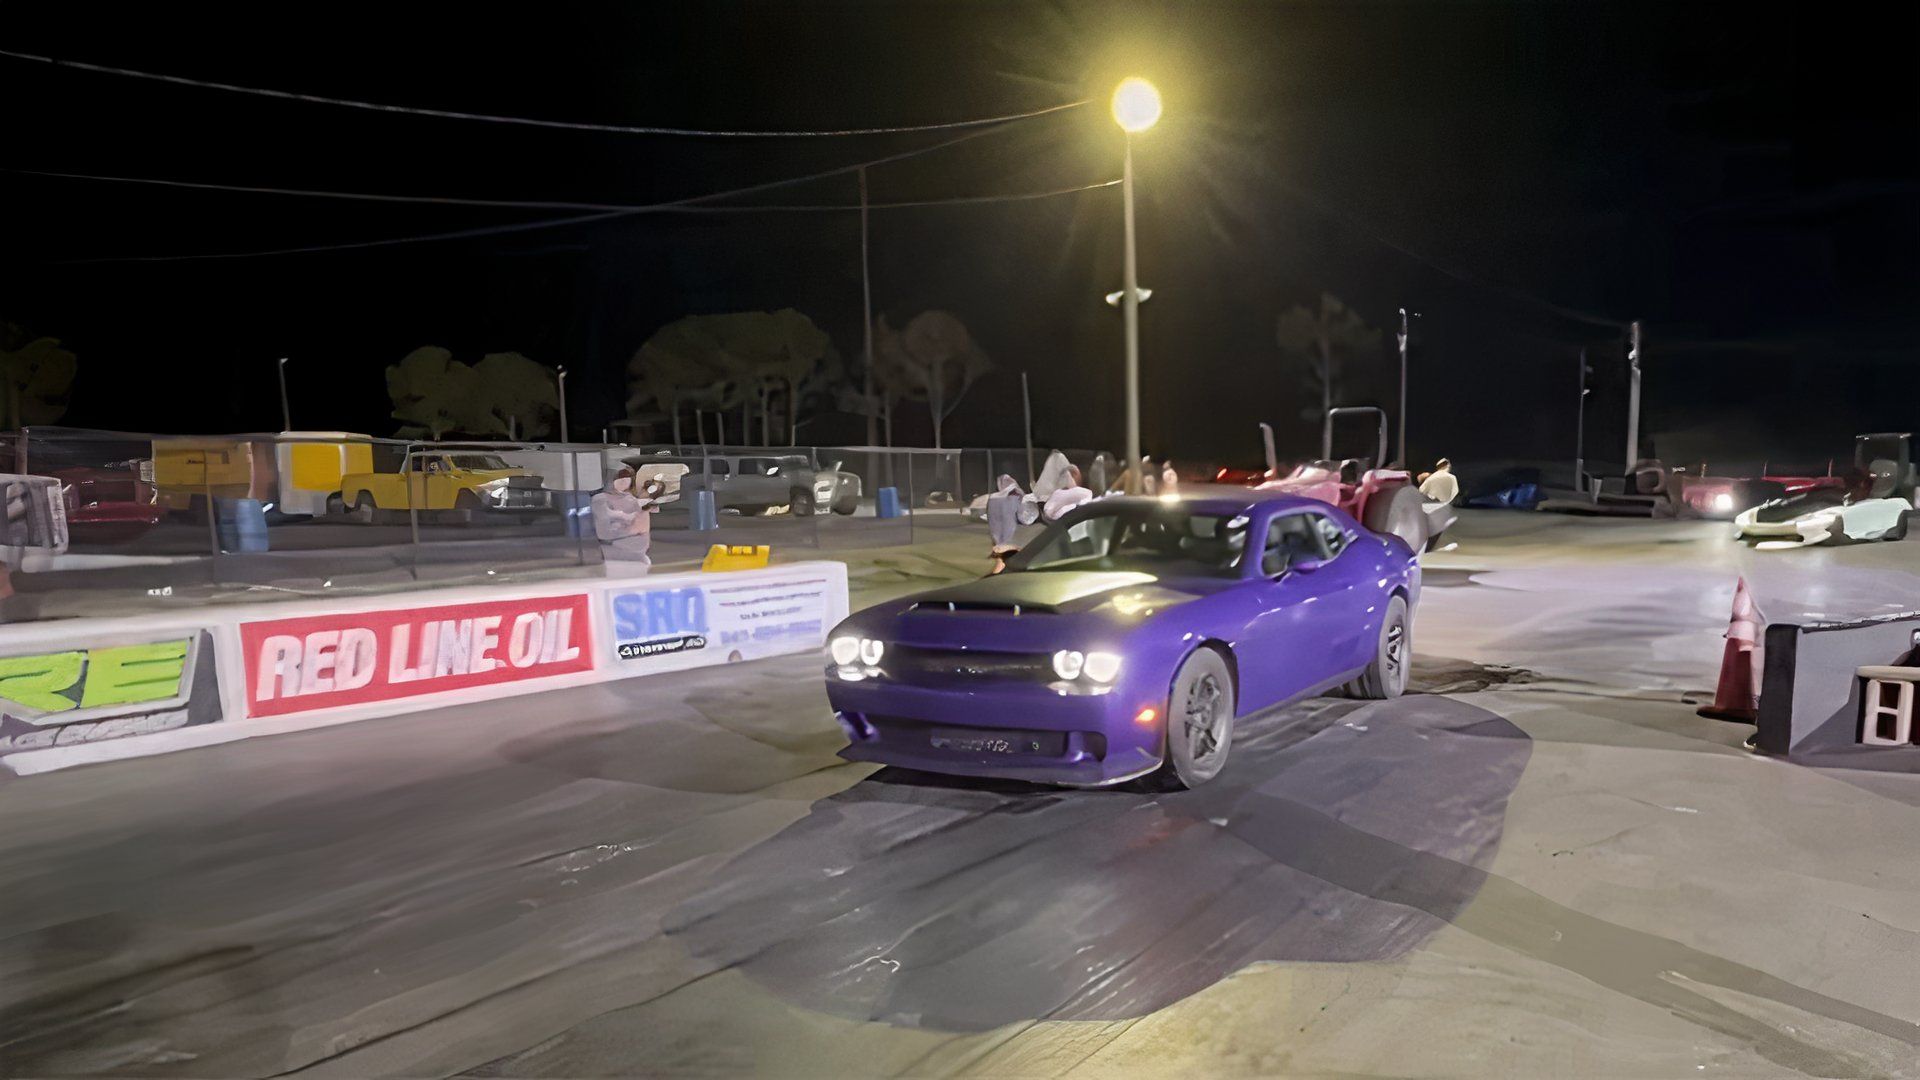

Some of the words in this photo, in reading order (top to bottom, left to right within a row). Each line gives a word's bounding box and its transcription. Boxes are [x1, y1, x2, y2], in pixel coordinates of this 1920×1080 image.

[256, 628, 377, 701] RED
[388, 615, 501, 684] LINE
[508, 607, 580, 668] OIL
